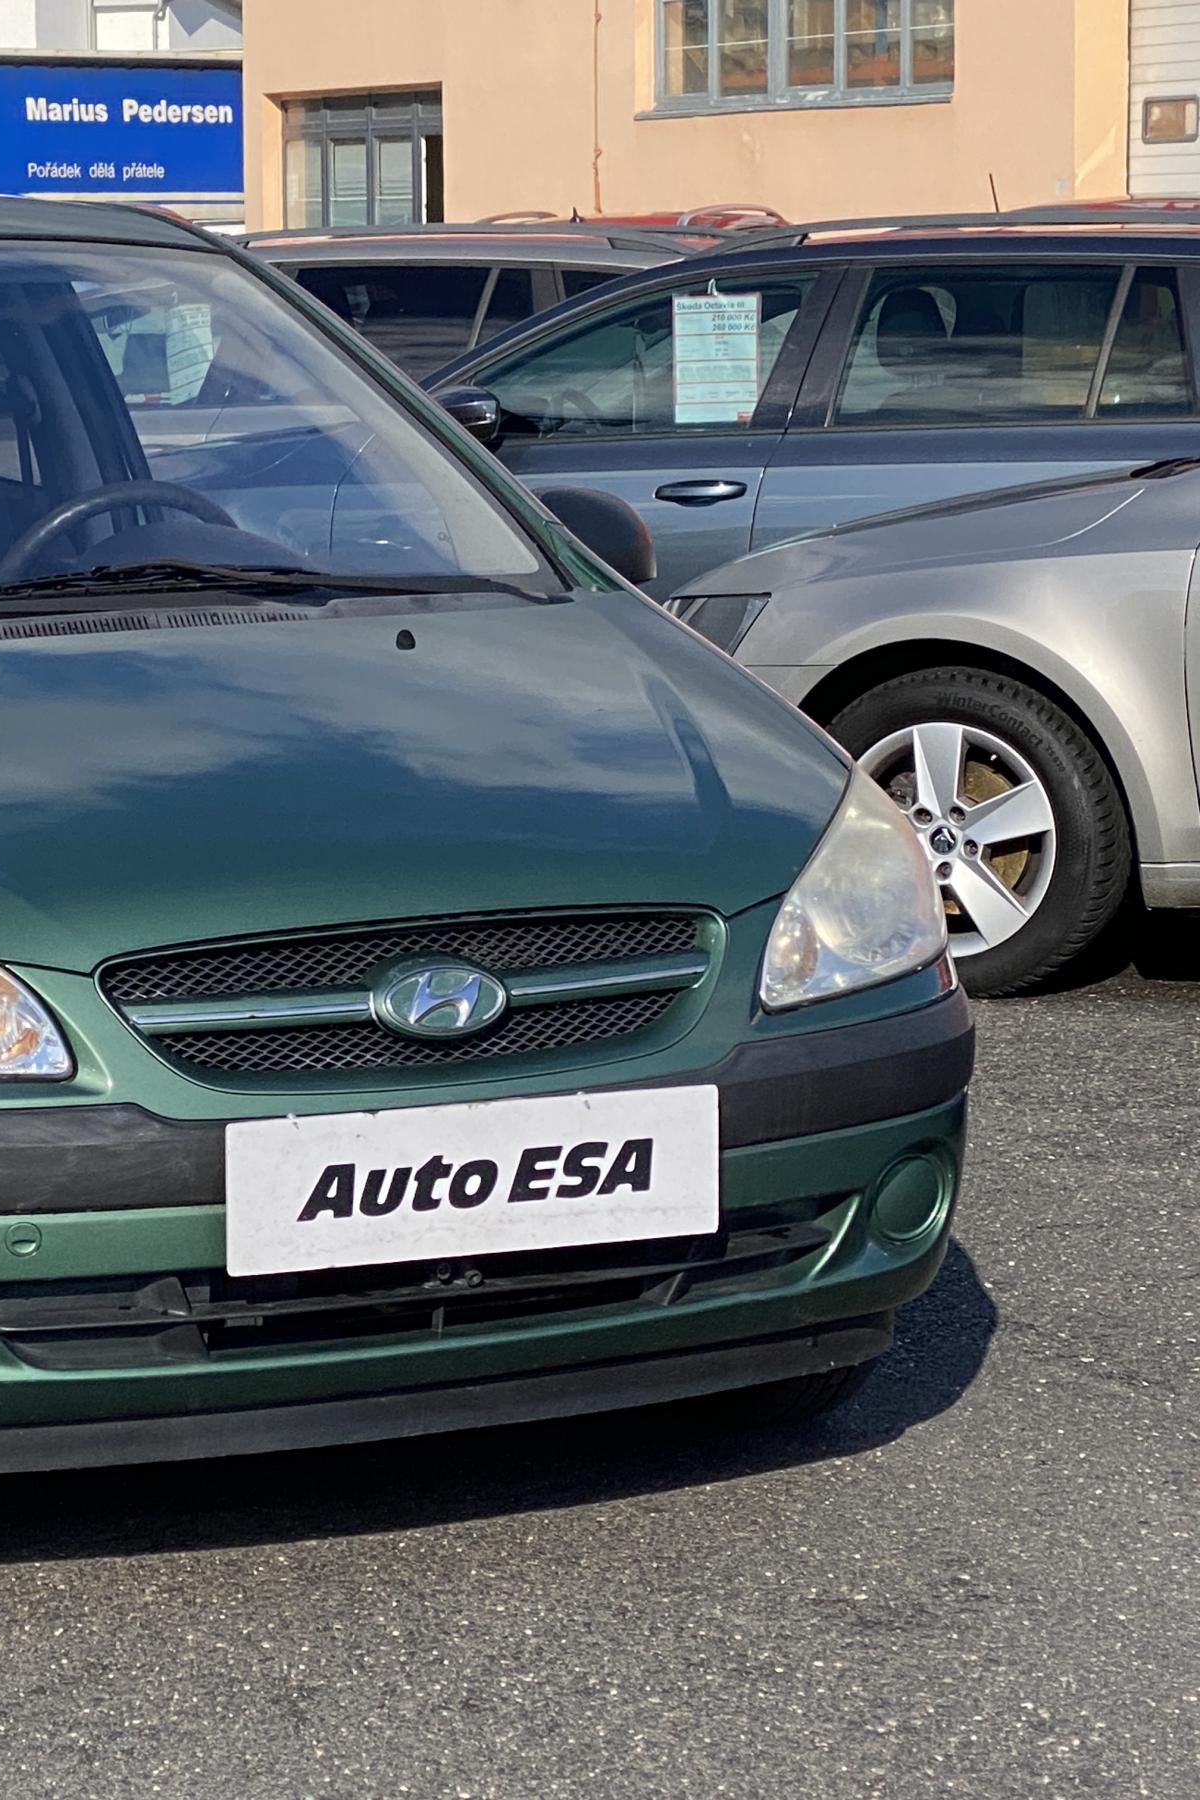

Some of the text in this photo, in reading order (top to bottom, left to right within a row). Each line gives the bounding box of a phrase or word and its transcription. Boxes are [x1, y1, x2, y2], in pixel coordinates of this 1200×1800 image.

[25, 97, 233, 124] Marius Pedersen
[27, 161, 165, 181] Pořádek dělá přátele
[676, 301, 702, 310] Škoda
[936, 690, 1044, 748] WinterContact
[296, 1138, 654, 1223] Auto ESA
